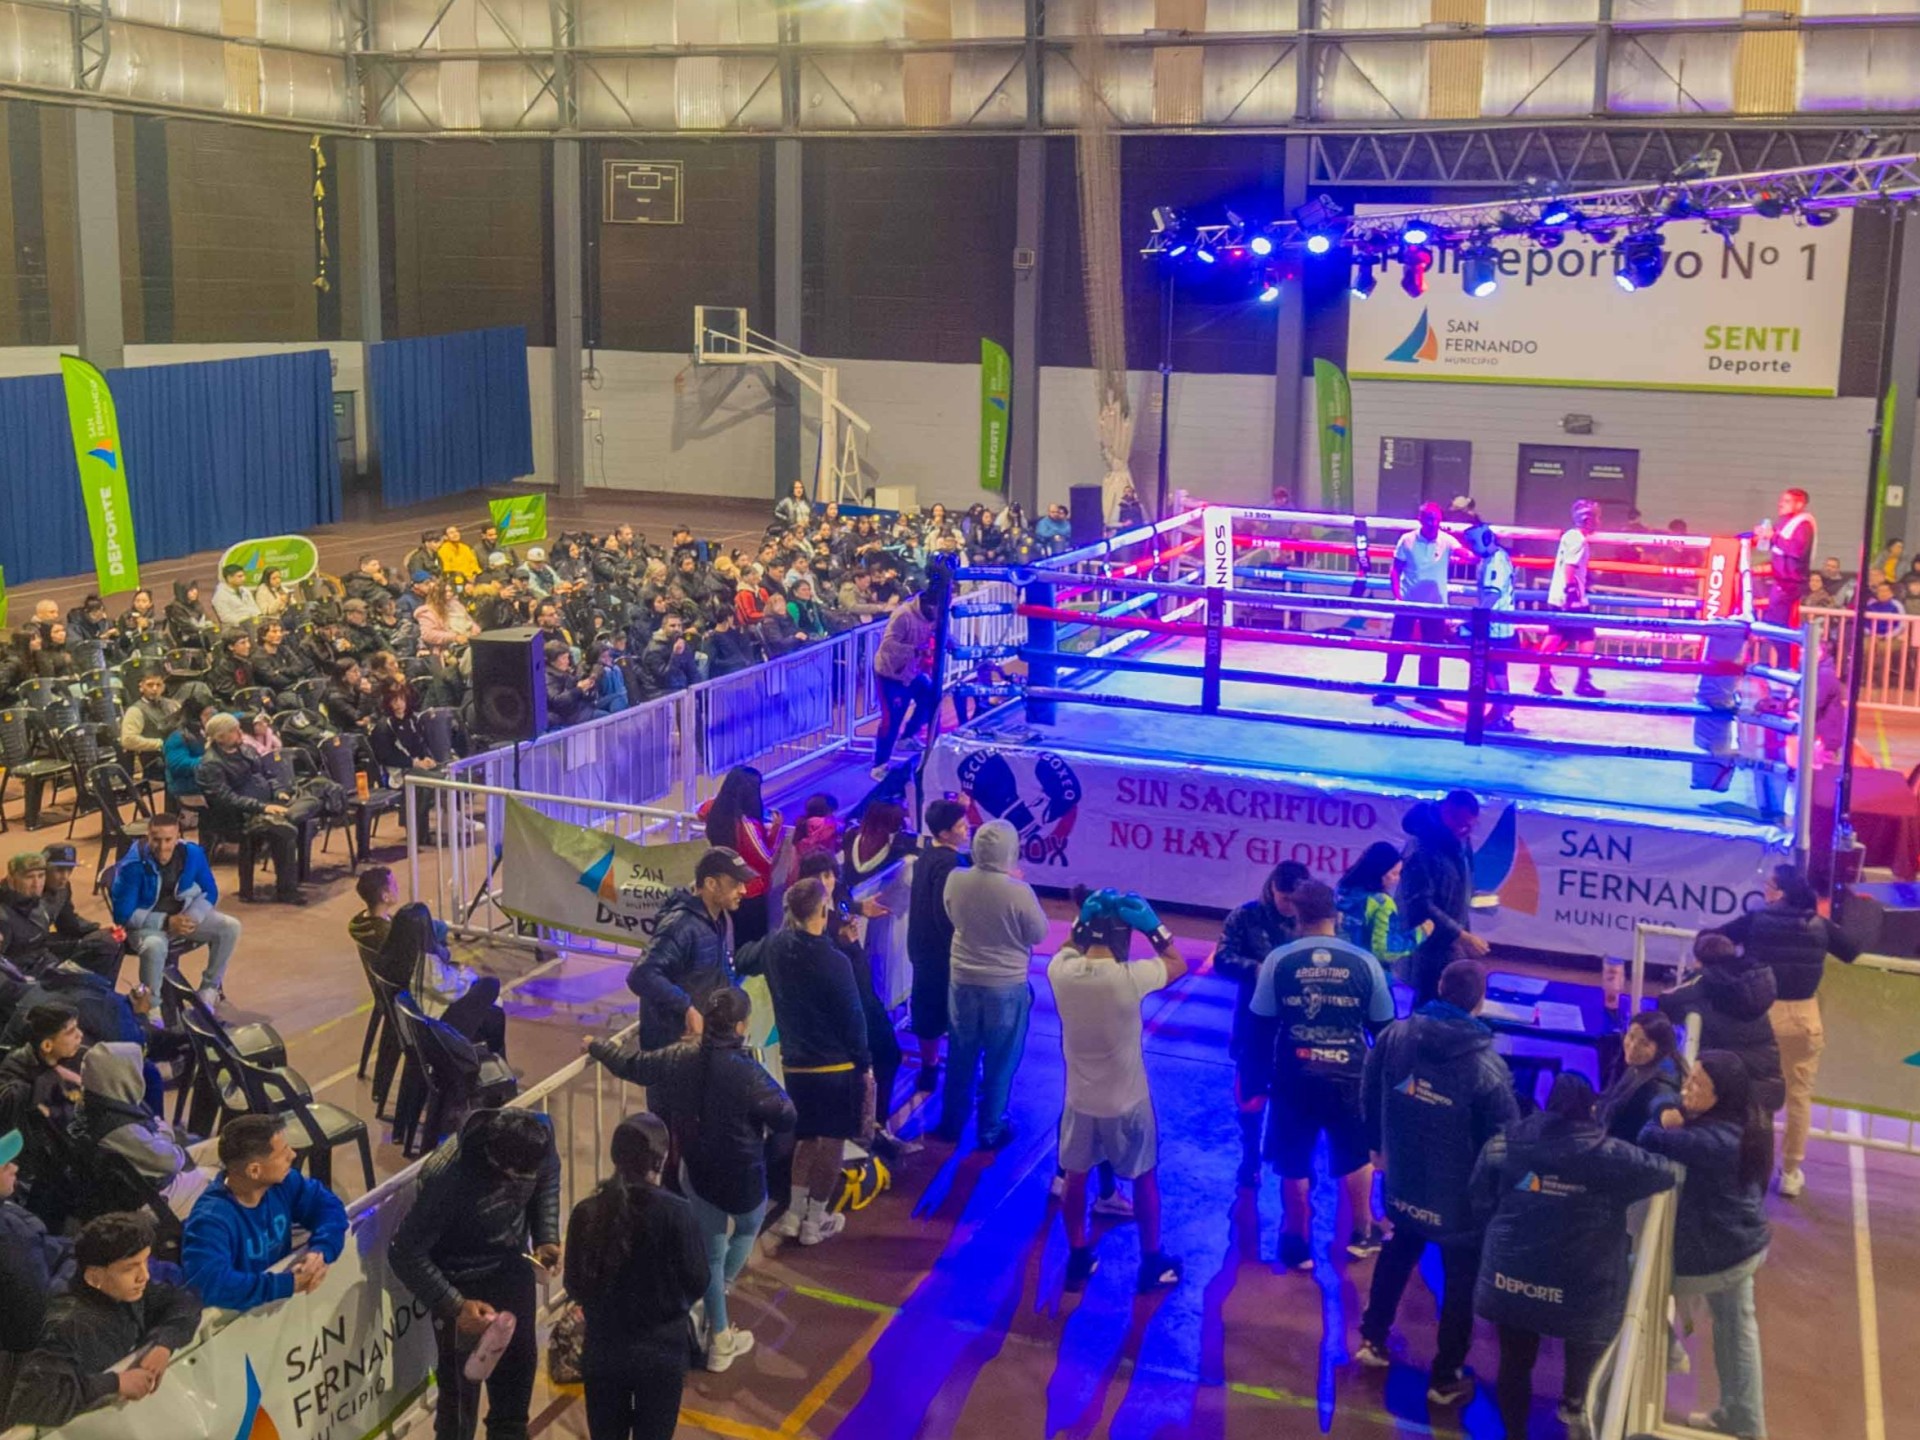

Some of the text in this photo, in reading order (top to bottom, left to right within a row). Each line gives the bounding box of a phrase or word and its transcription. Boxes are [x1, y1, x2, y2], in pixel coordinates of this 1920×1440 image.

[1800, 243, 1817, 280] 1
[1446, 319, 1479, 333] SAN
[1703, 325, 1800, 352] SENTI
[1445, 338, 1538, 355] FERNANDO
[1708, 356, 1791, 374] Deporte
[100, 486, 124, 576] DEPORTE
[963, 748, 1000, 790] ESCUE
[1116, 776, 1377, 830] SIN SACRIFICIO
[1019, 833, 1069, 868] OX
[1110, 820, 1352, 874] NO HAY GLORI
[1559, 829, 1632, 863] SAN
[629, 863, 664, 882] SAN
[595, 902, 657, 936] DEPO
[1494, 1271, 1564, 1304] DEPORTE
[286, 1315, 346, 1383] SAN
